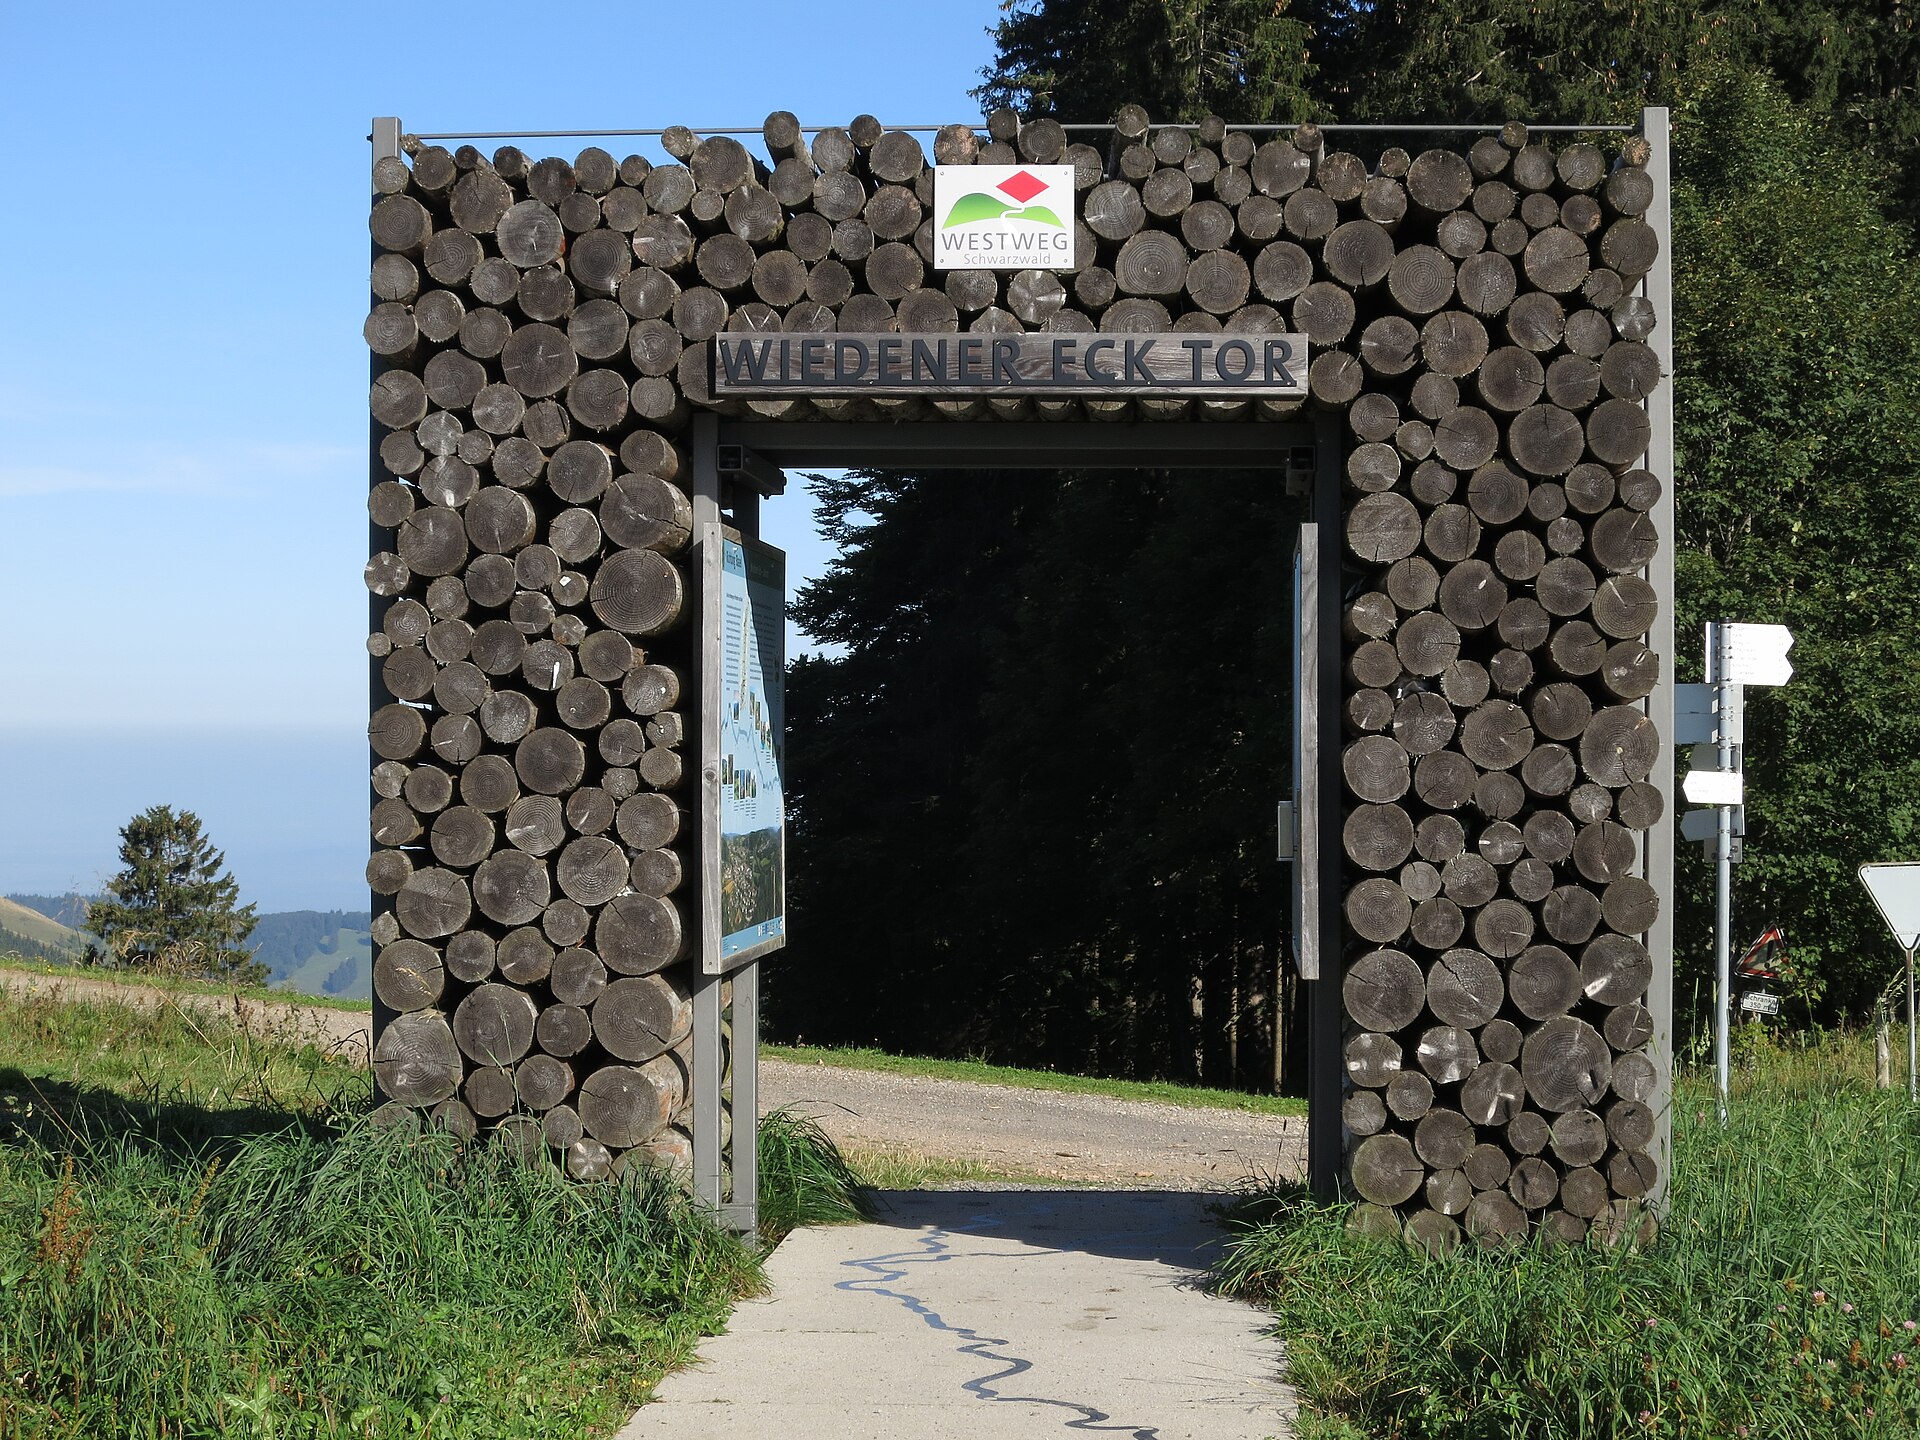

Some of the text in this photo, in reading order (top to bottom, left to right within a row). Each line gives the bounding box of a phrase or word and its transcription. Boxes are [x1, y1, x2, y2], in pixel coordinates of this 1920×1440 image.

[941, 232, 1068, 250] WESTWEG
[964, 253, 1051, 266] Schwarzwald
[719, 339, 1296, 385] WIEDENER ECK TOR
